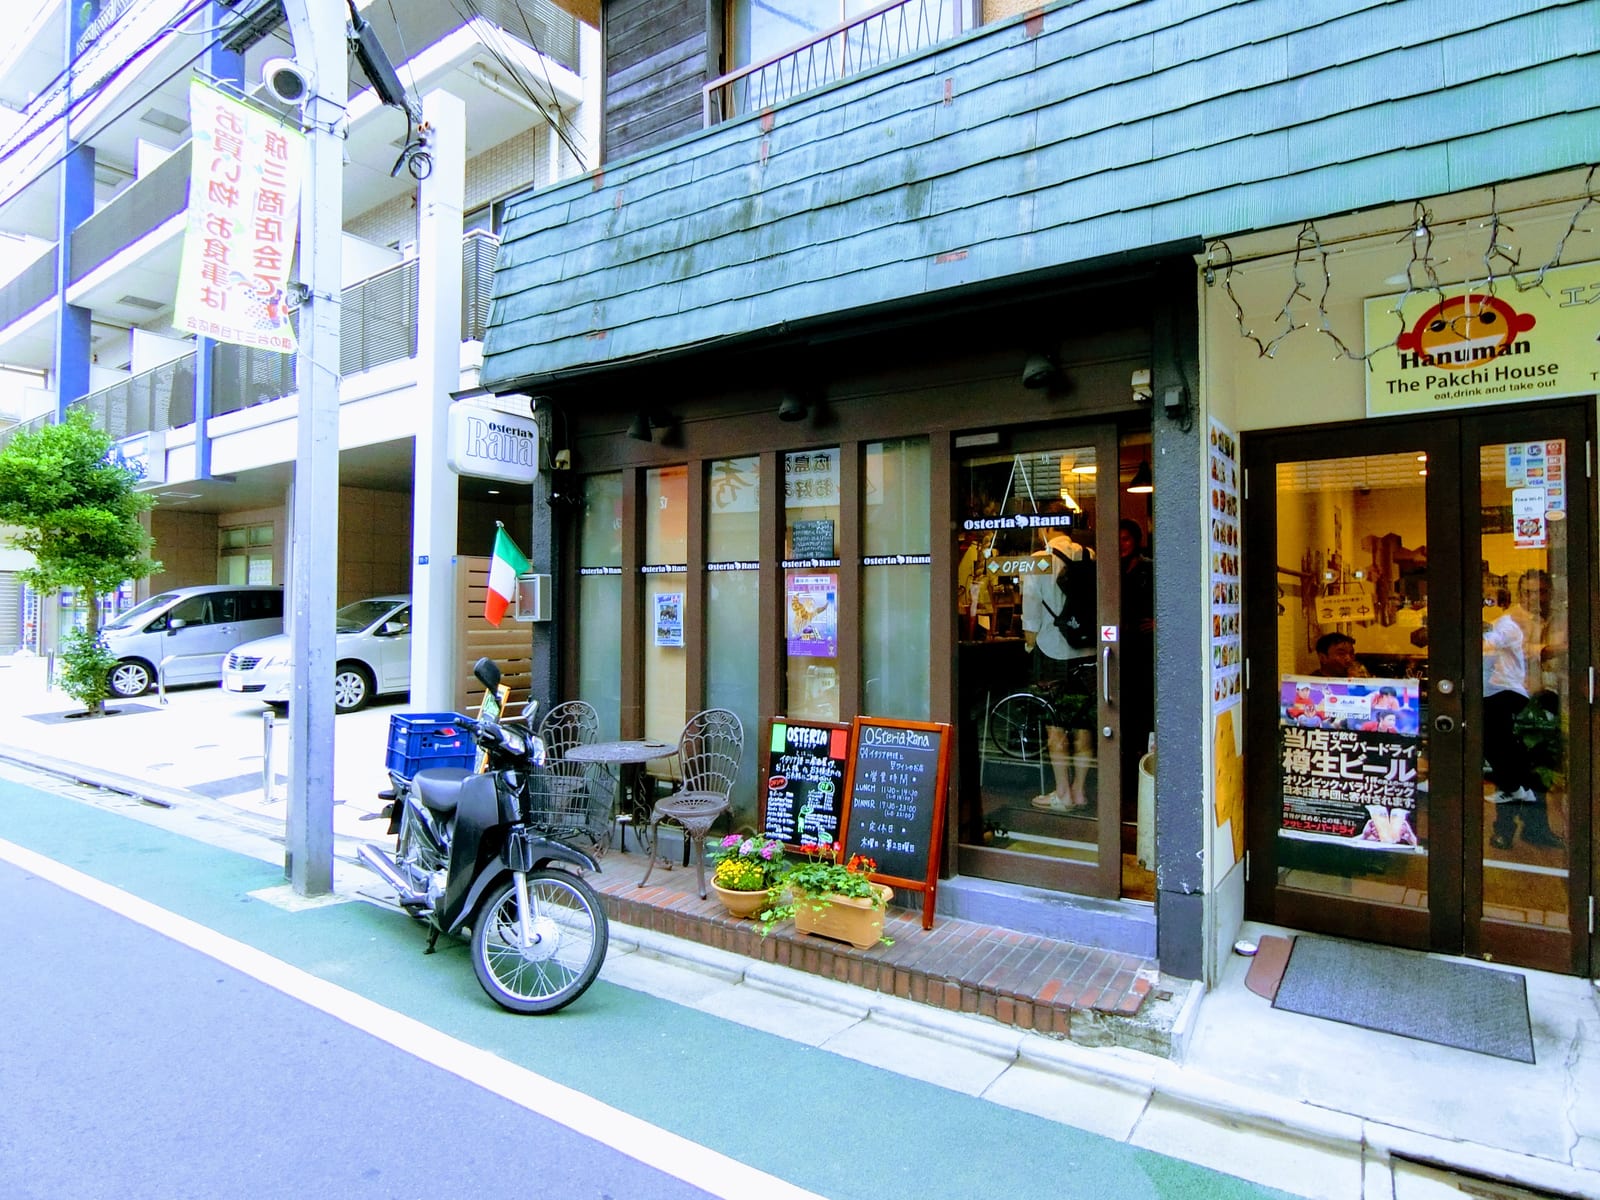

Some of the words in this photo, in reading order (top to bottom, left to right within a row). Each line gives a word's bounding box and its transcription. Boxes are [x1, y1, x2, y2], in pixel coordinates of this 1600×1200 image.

[1400, 340, 1530, 369] Hanuman
[1386, 380, 1420, 395] The
[1426, 368, 1488, 390] Pakchi
[1496, 363, 1559, 381] House
[1485, 384, 1506, 395] and
[1509, 381, 1534, 392] take
[1537, 379, 1556, 389] out
[466, 417, 533, 467] Rana
[964, 518, 1015, 530] Osteria
[1029, 515, 1071, 527] Rana
[864, 557, 896, 565] Osteria
[1002, 561, 1035, 573] OPEN
[787, 727, 827, 745] OSTERIA
[906, 730, 930, 747] Rana
[1283, 727, 1330, 751] 当店
[1330, 731, 1357, 742] で飲む
[1329, 740, 1416, 759] スーパードライ
[1282, 748, 1417, 782] 樽生ビール
[870, 771, 908, 785] 営業時間
[855, 783, 876, 793] LUNCH
[854, 797, 876, 809] DINNER
[868, 822, 894, 833] 定休日
